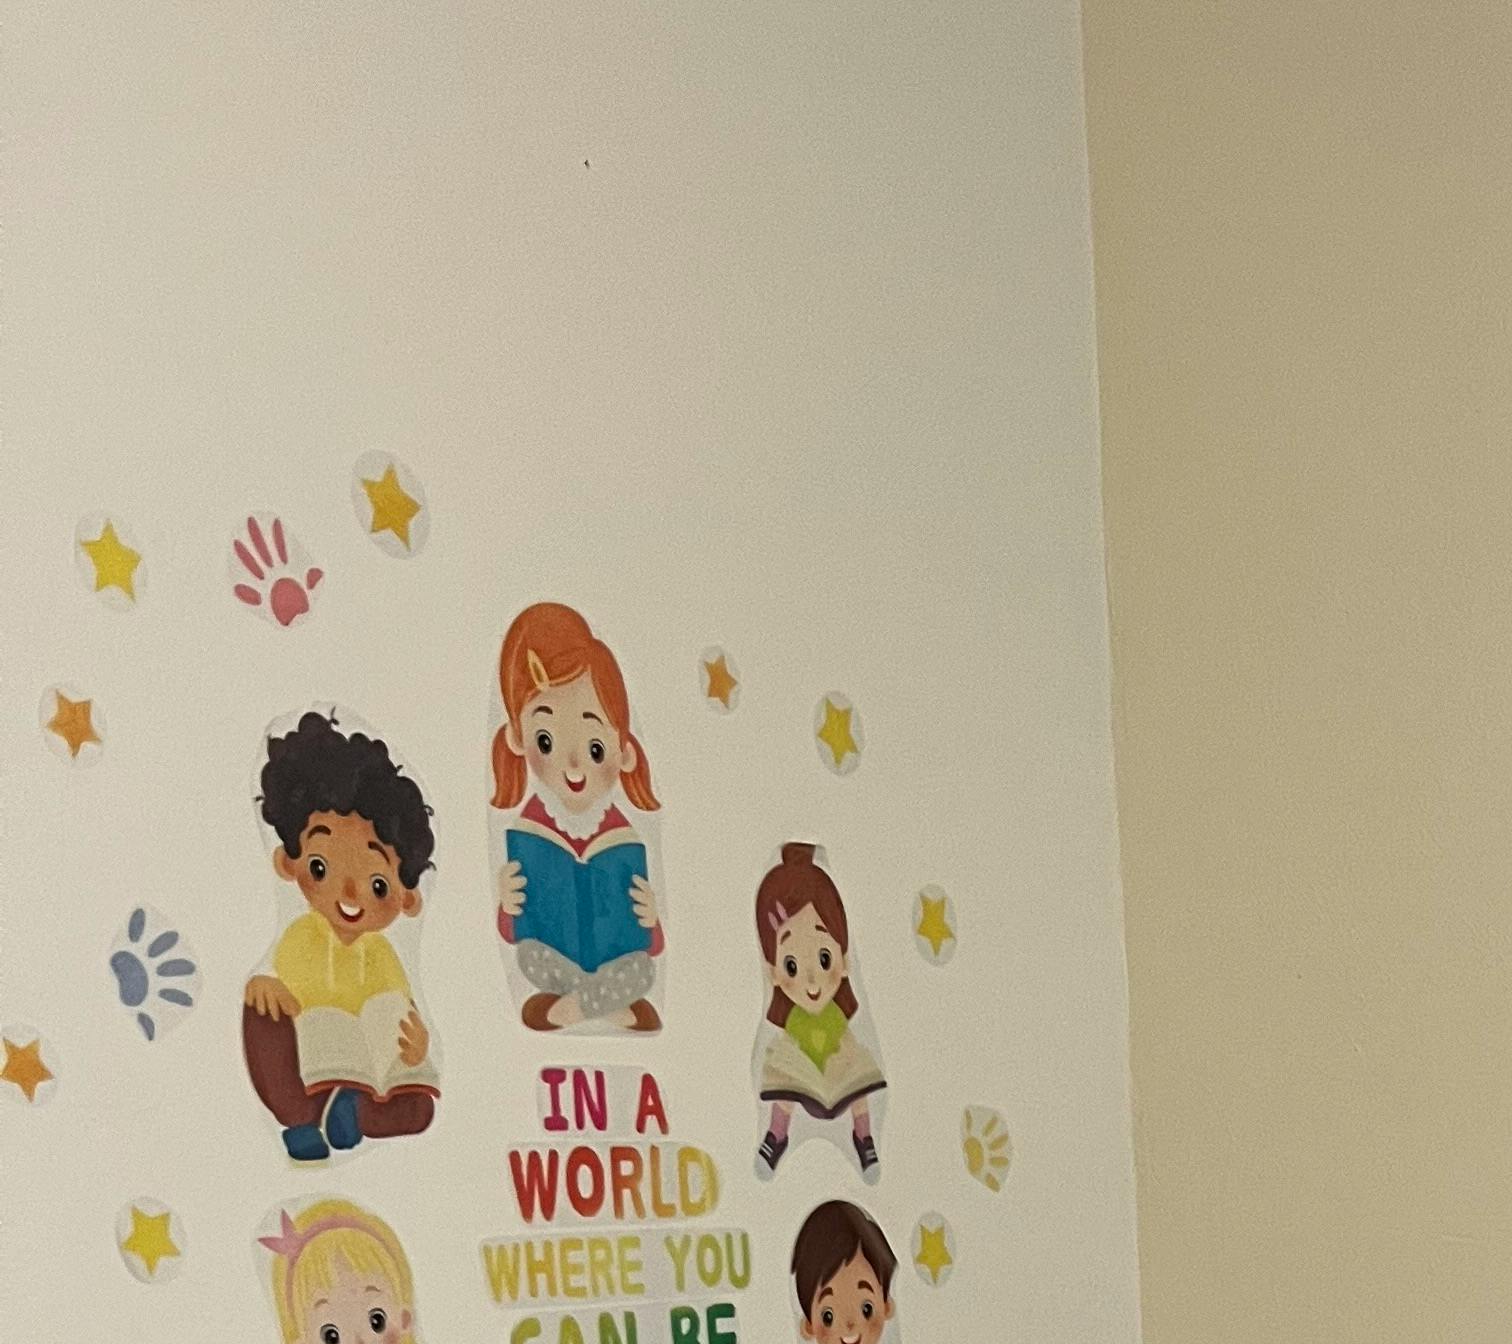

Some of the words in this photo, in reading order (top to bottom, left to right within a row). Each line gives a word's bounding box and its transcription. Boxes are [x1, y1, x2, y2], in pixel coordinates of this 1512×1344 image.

[541, 1068, 607, 1131] IN
[636, 1073, 669, 1135] A
[509, 1144, 720, 1223] WORLD
[482, 1235, 645, 1305] WHERE
[664, 1232, 751, 1292] YOU
